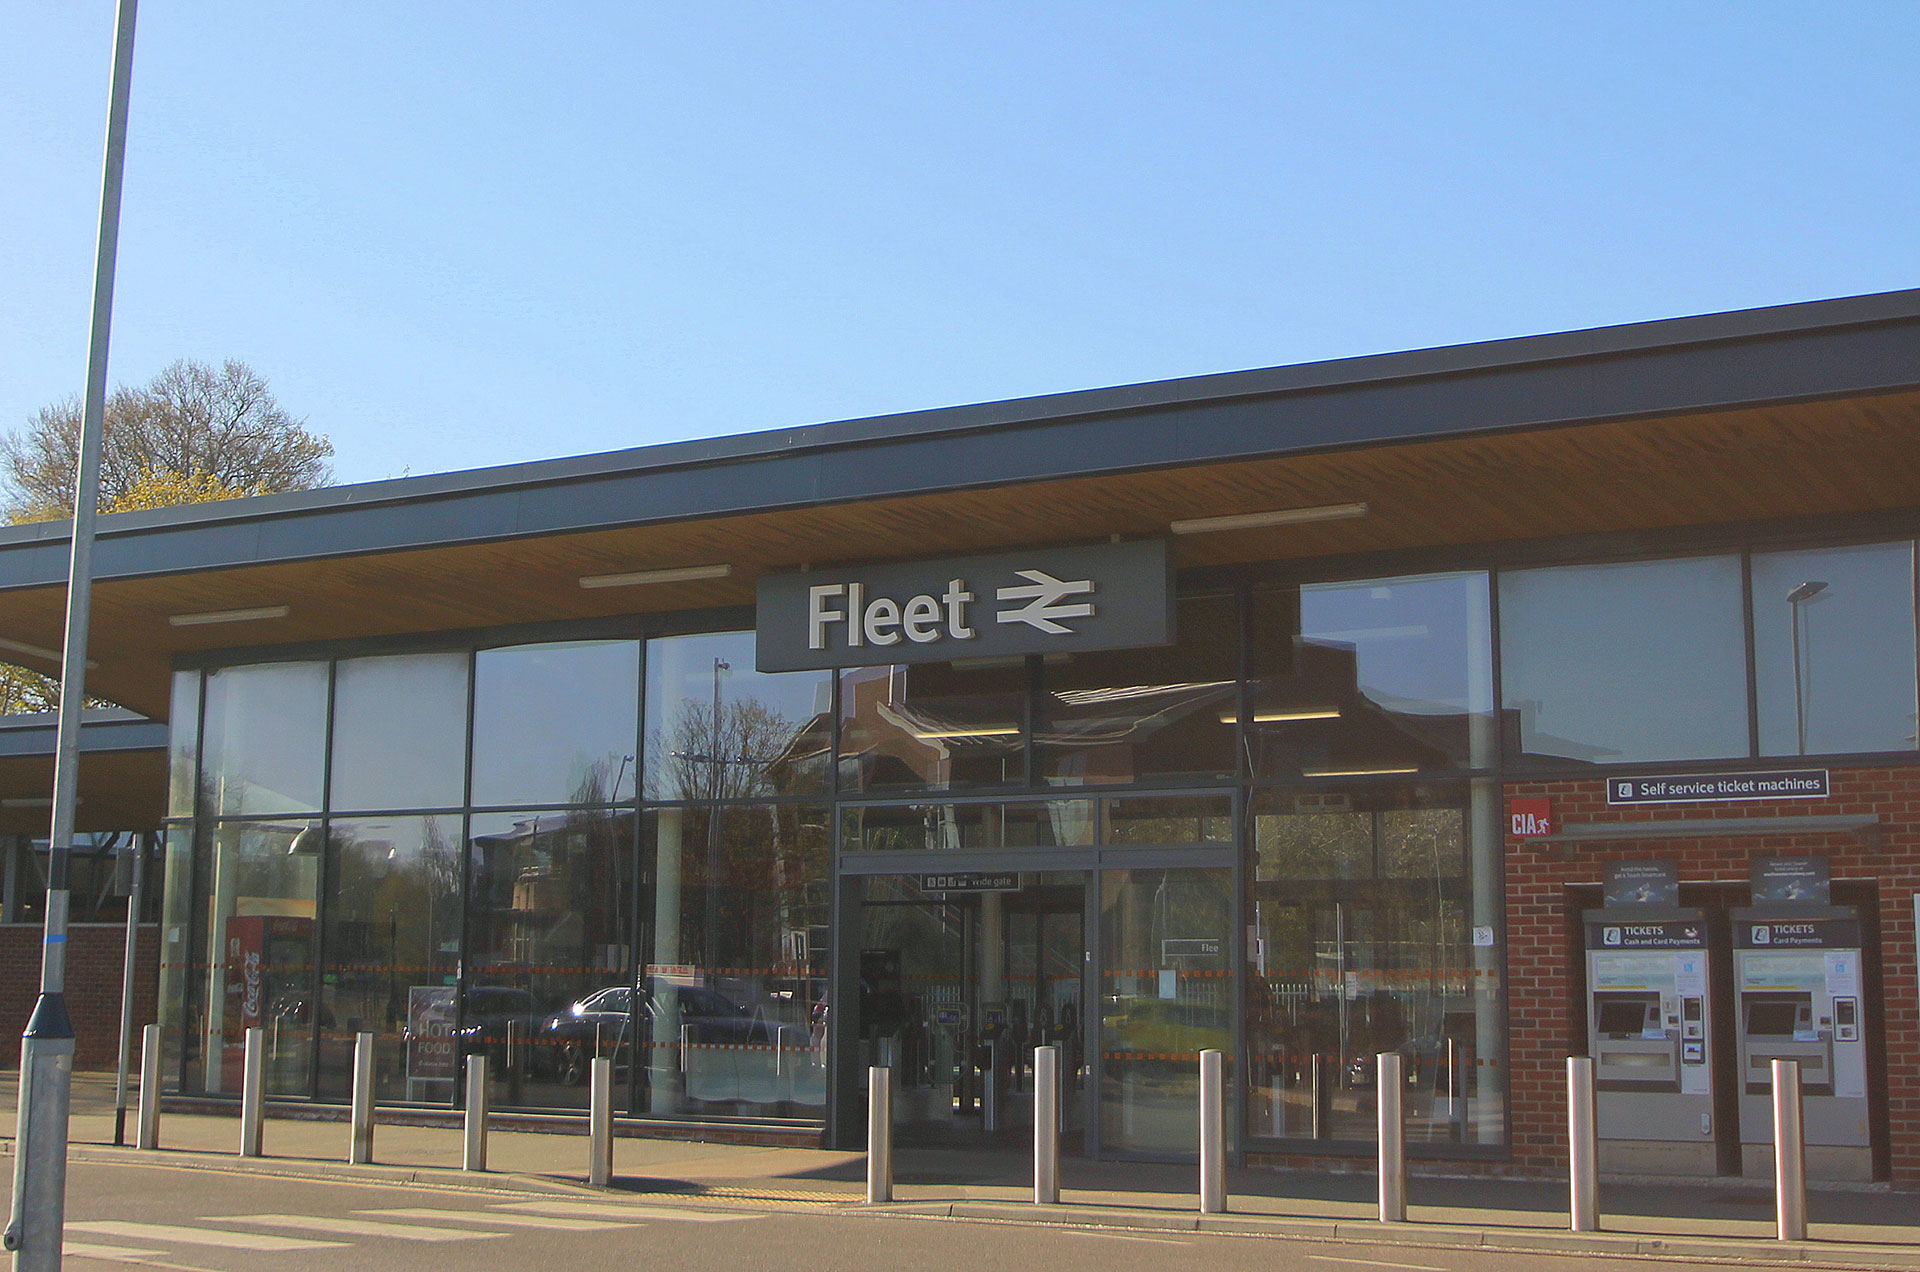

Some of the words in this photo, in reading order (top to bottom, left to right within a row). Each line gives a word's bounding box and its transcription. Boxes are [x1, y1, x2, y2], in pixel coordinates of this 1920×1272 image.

[809, 578, 976, 649] Fleet
[1640, 782, 1666, 796] Self
[1668, 782, 1715, 795] service
[1717, 779, 1755, 792] ticket
[1758, 777, 1821, 791] machines
[1511, 813, 1537, 834] CIA
[993, 877, 1012, 888] gate
[1623, 926, 1664, 936] TICKETS
[1773, 924, 1815, 934] TICKETS
[1623, 938, 1640, 946] Cash
[1640, 938, 1653, 946] and
[1653, 938, 1668, 946] Card
[1669, 938, 1701, 946] Payments
[1790, 937, 1823, 945] Payments
[243, 950, 260, 1017] Coca-Cola
[419, 1022, 452, 1038] HOT
[418, 1041, 451, 1055] FOOD
